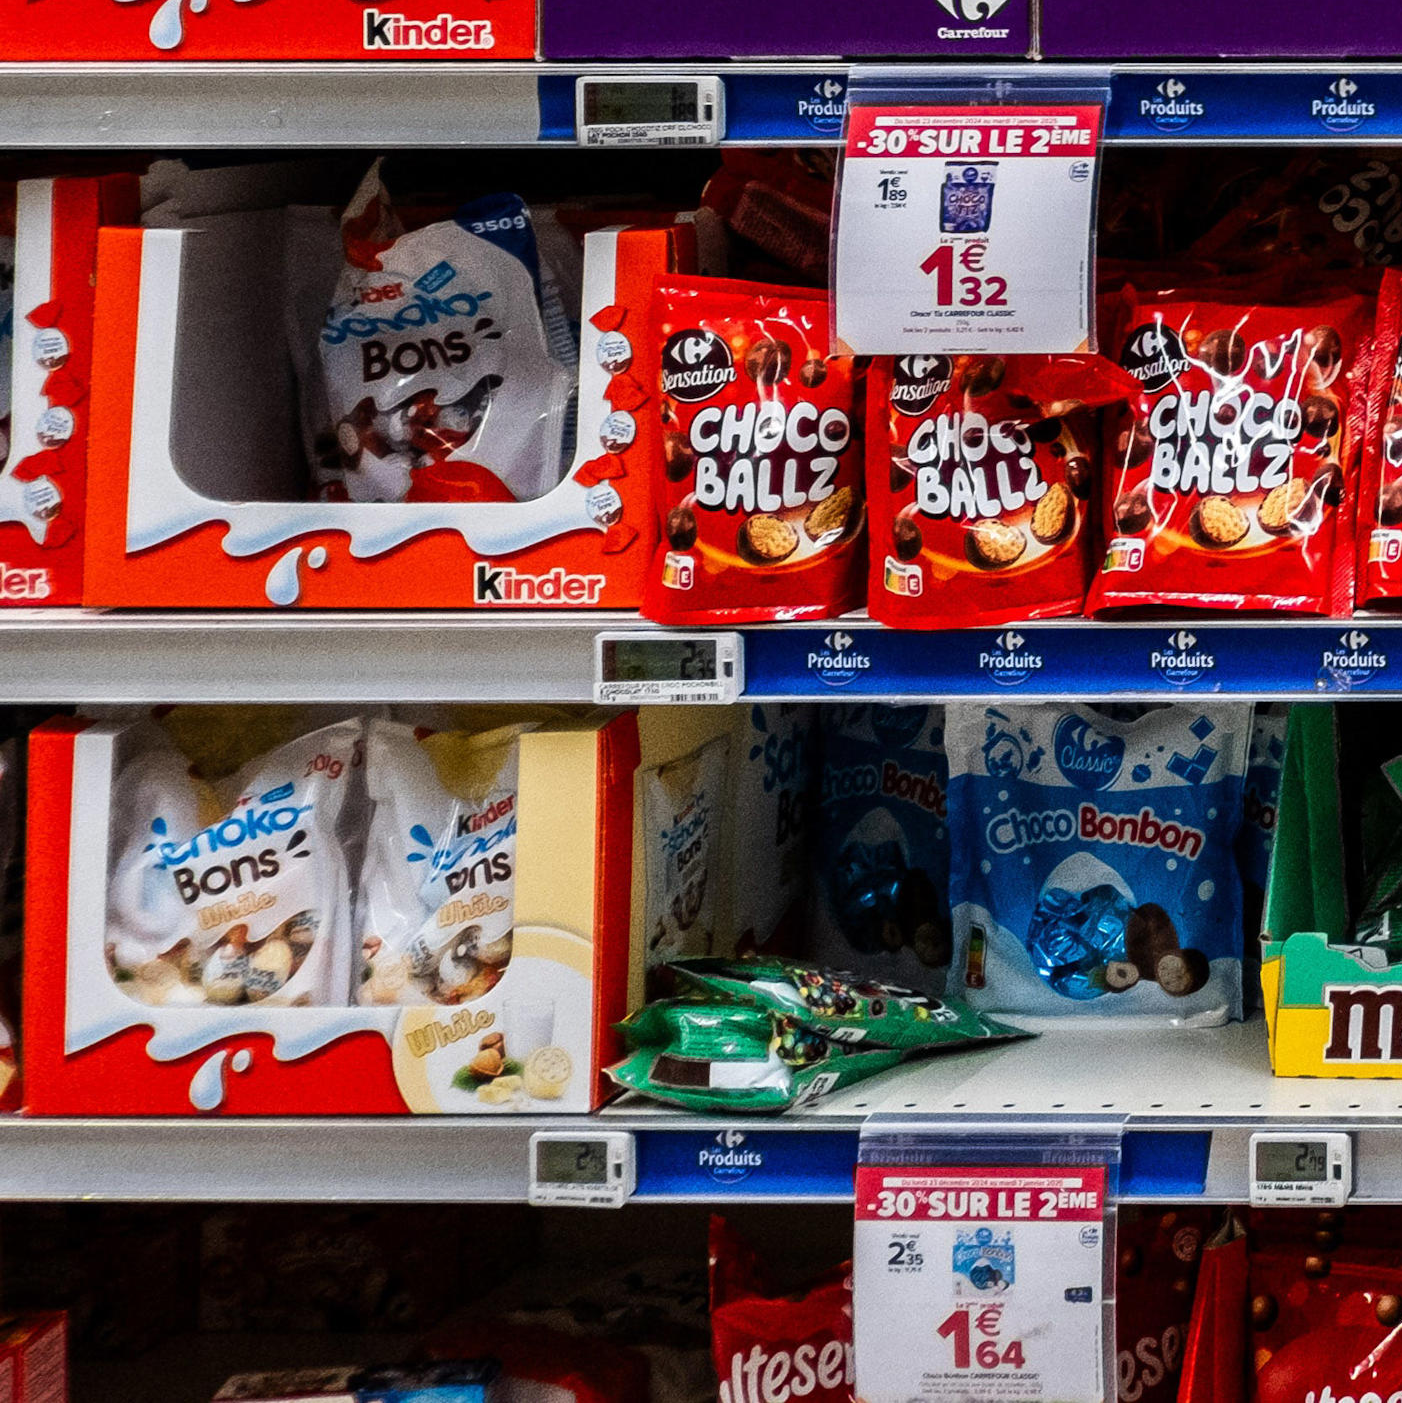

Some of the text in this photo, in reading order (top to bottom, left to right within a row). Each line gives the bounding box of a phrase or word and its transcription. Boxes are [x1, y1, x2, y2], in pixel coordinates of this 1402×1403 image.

[937, 26, 1009, 39] Carrefour
[1140, 98, 1204, 118] Produits
[1311, 98, 1376, 118] Produits
[918, 128, 982, 155] SUR
[988, 128, 1025, 154] LE
[1029, 125, 1092, 154] 2ÈME
[471, 213, 527, 234] 350g
[360, 331, 473, 384] Bons
[660, 364, 738, 392] Sensation
[689, 401, 851, 453] CHOCO
[1149, 392, 1301, 441] CHOCO
[695, 456, 839, 511] BALLZ
[914, 463, 1049, 518] BALLZ
[476, 567, 602, 601] Kinder
[807, 653, 871, 671] Produits
[979, 653, 1043, 671] Produits
[1151, 651, 1215, 671] Produits
[1059, 745, 1119, 775] Classic
[987, 802, 1205, 859] Choco Bonbon
[174, 847, 281, 906] Bons
[405, 1008, 496, 1060] White
[698, 1148, 762, 1169] Produits
[927, 1191, 989, 1218] SUR
[997, 1191, 1032, 1218] LE
[1038, 1188, 1097, 1218] 2ÈME
